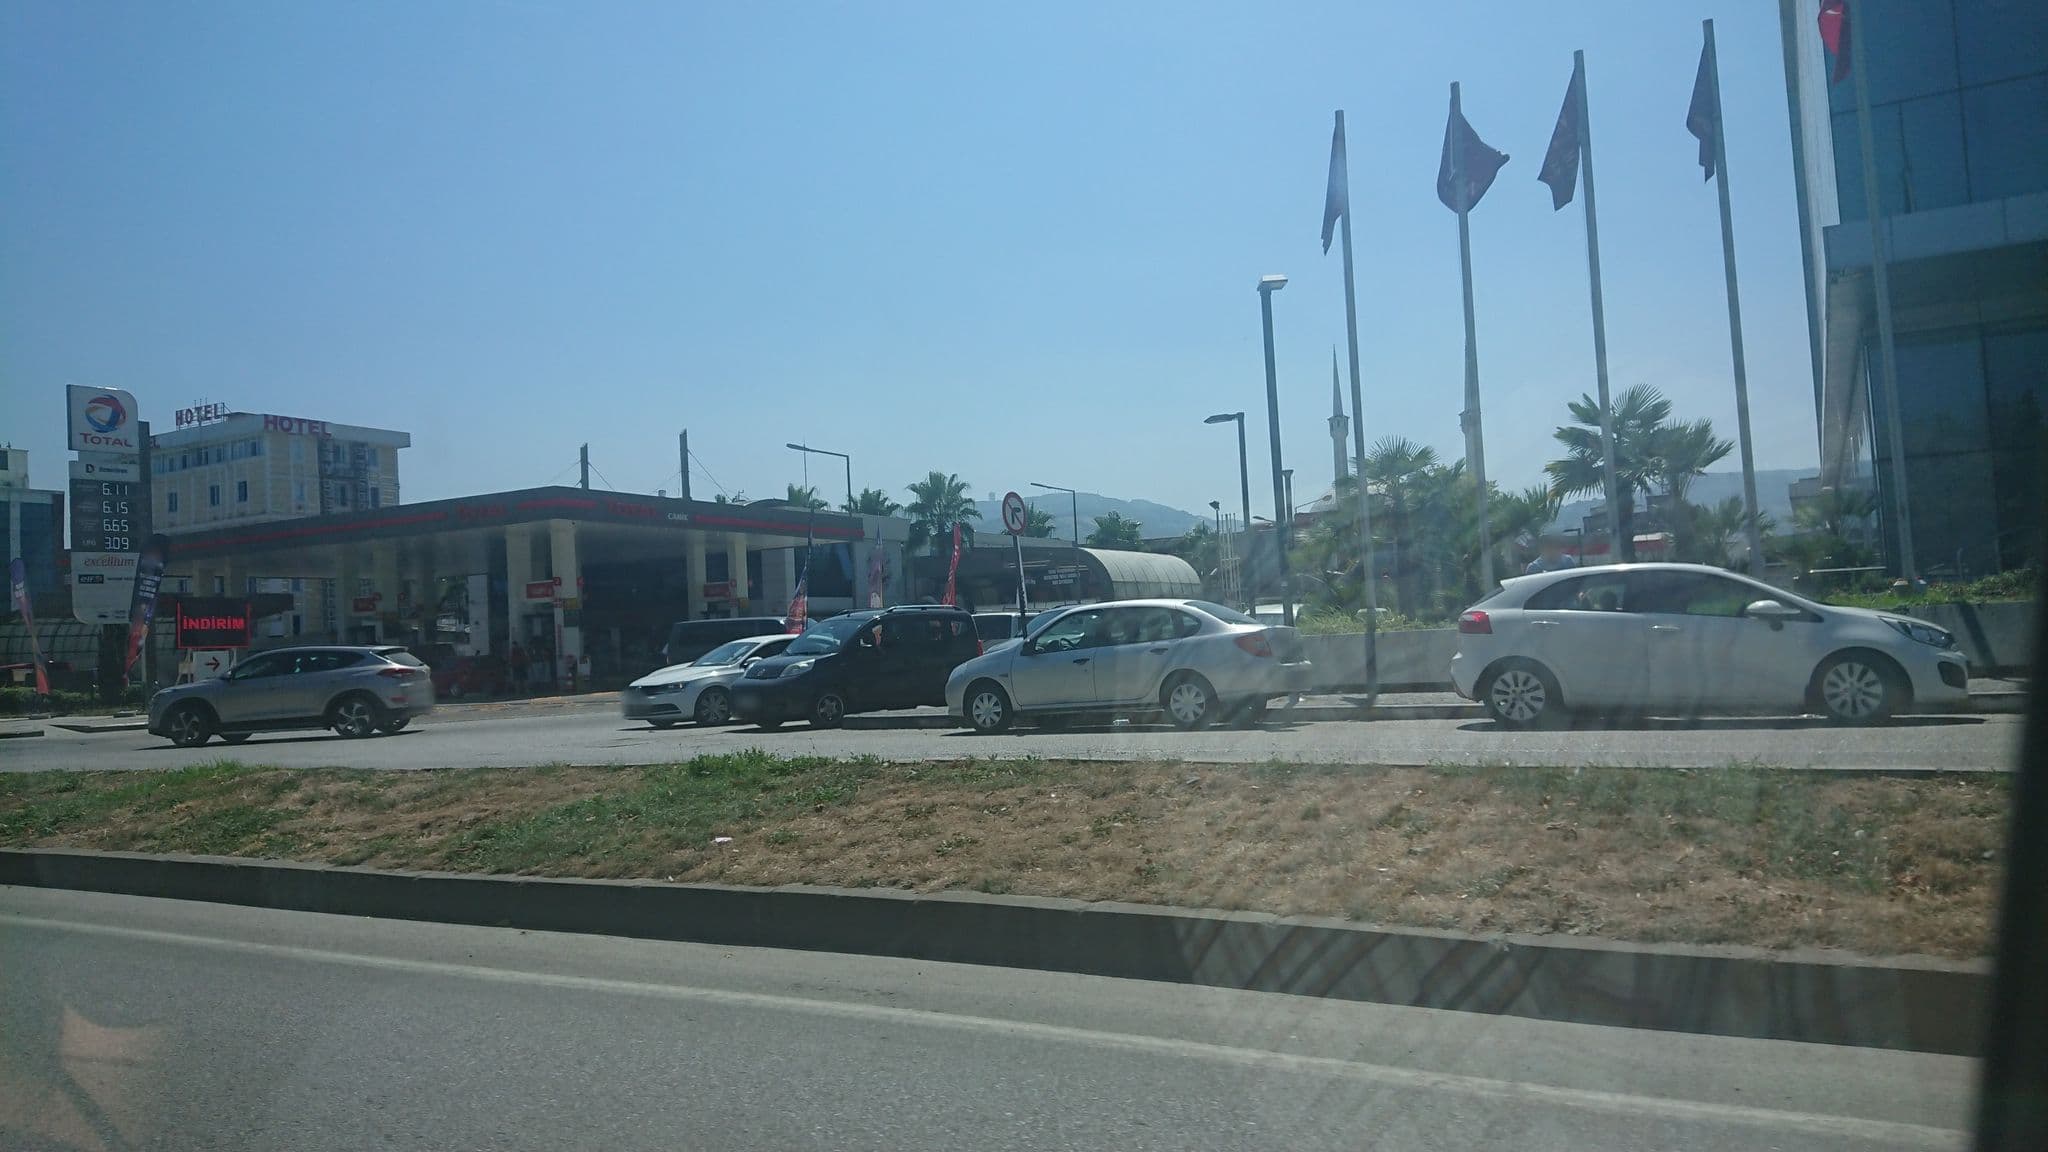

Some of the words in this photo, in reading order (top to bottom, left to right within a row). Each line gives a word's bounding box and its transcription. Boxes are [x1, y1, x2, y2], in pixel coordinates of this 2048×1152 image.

[175, 403, 221, 426] HOTEL
[263, 414, 332, 436] HOTEL
[79, 432, 133, 448] TOTAL
[102, 482, 128, 496] 6.11
[102, 500, 129, 514] 6.15
[103, 519, 129, 532] 6.65
[84, 555, 135, 567] excellium
[183, 615, 244, 630] İNDİRİM
